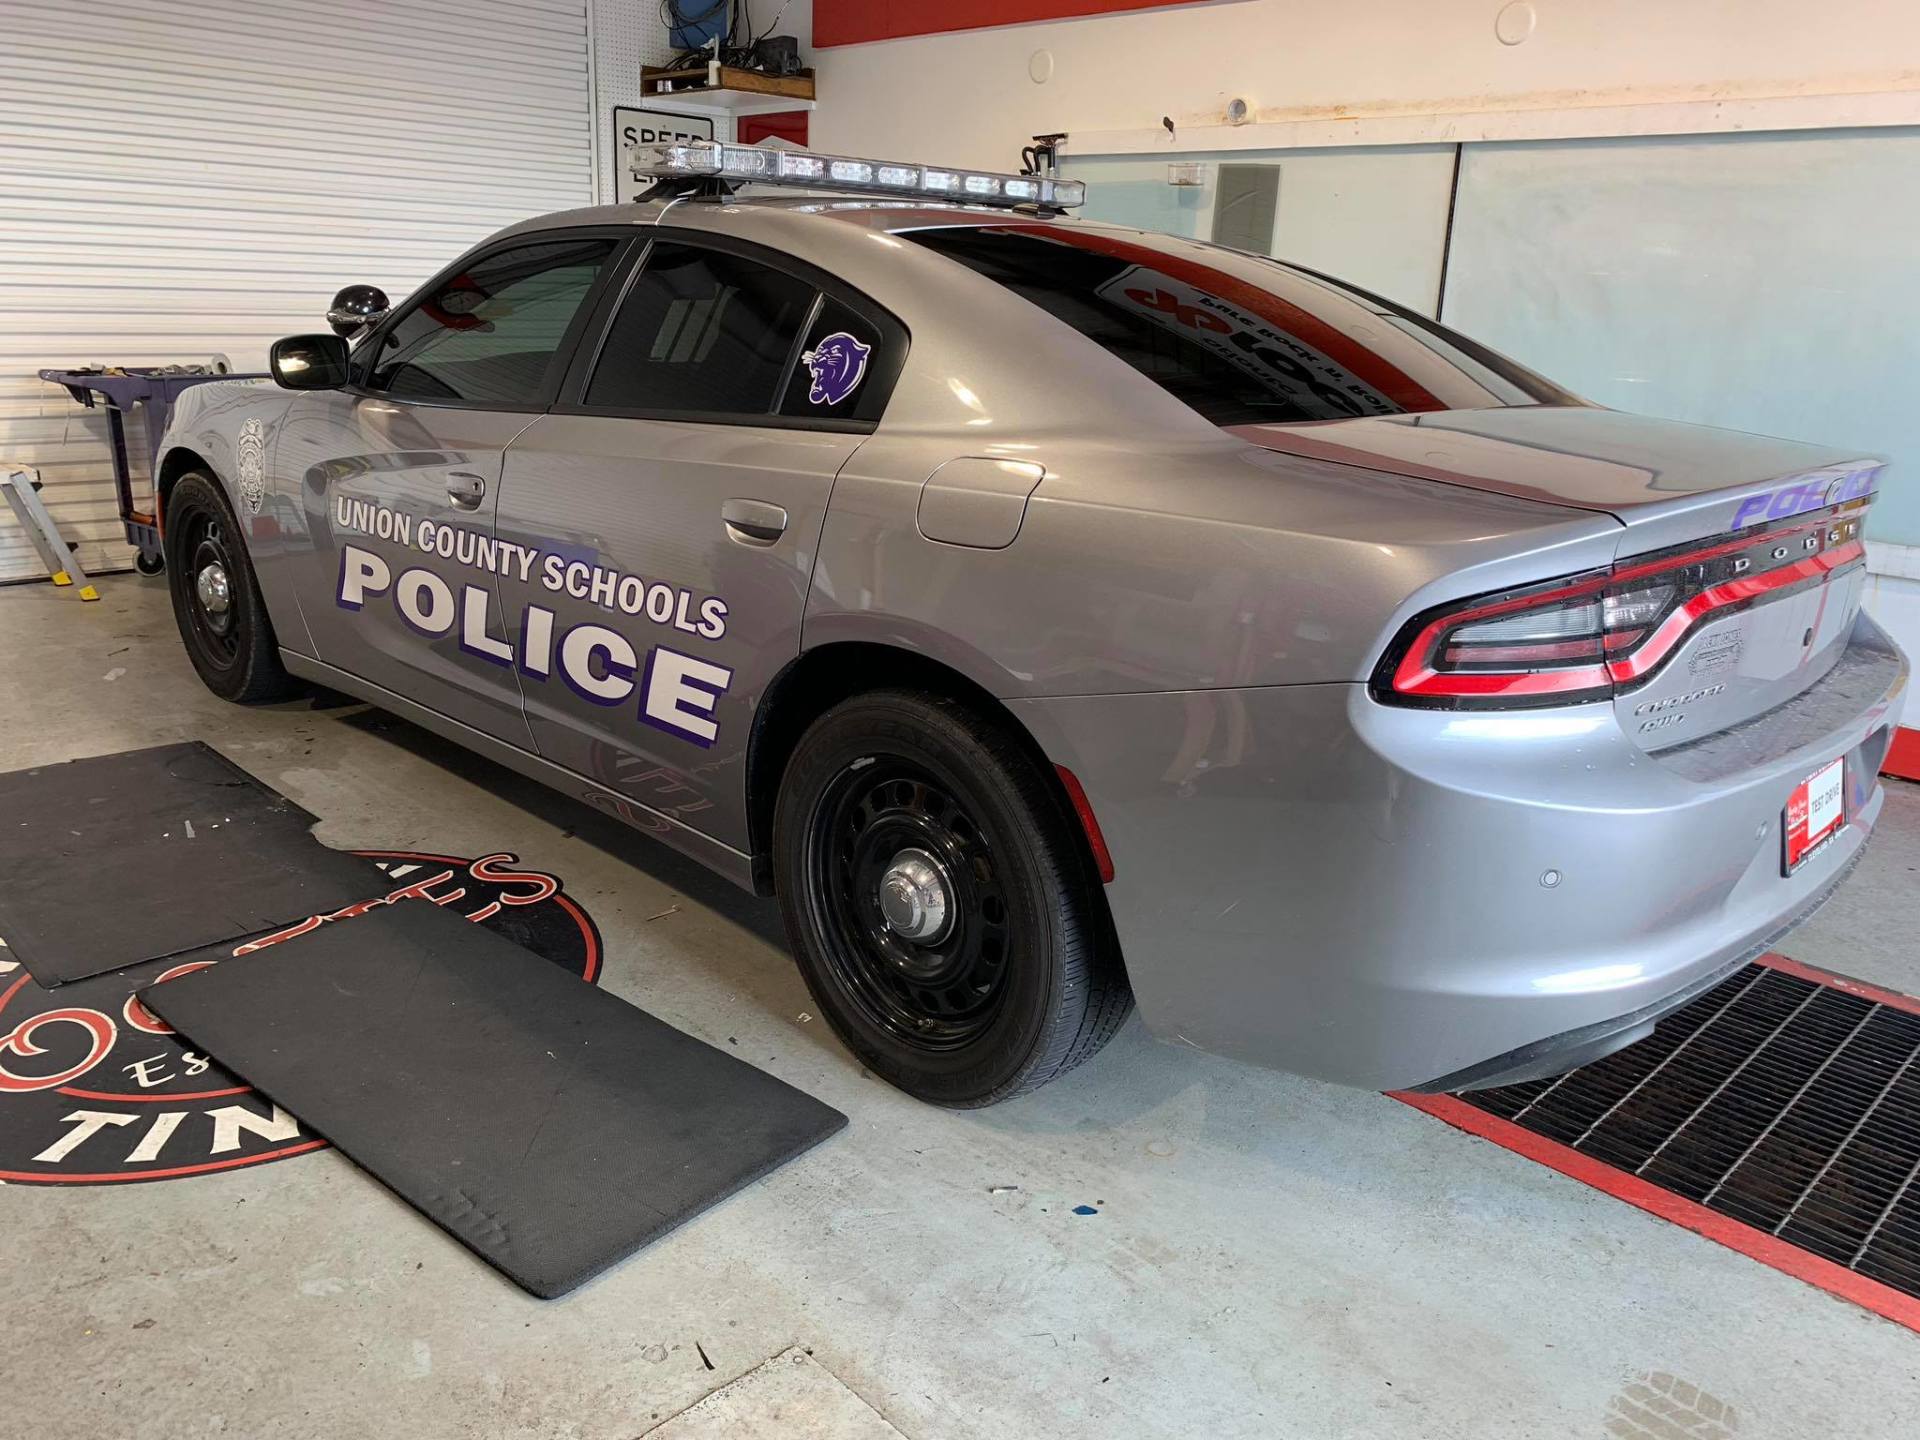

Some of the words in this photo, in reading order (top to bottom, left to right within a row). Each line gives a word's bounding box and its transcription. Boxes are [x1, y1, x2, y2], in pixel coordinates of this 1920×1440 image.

[623, 126, 705, 147] SPE
[336, 496, 411, 546] UNION
[417, 520, 537, 582] COUNTY
[541, 554, 730, 640] SCHOOLS
[1734, 523, 1858, 572] DODGE
[336, 544, 735, 750] POLICE
[31, 1104, 301, 1164] TIN
